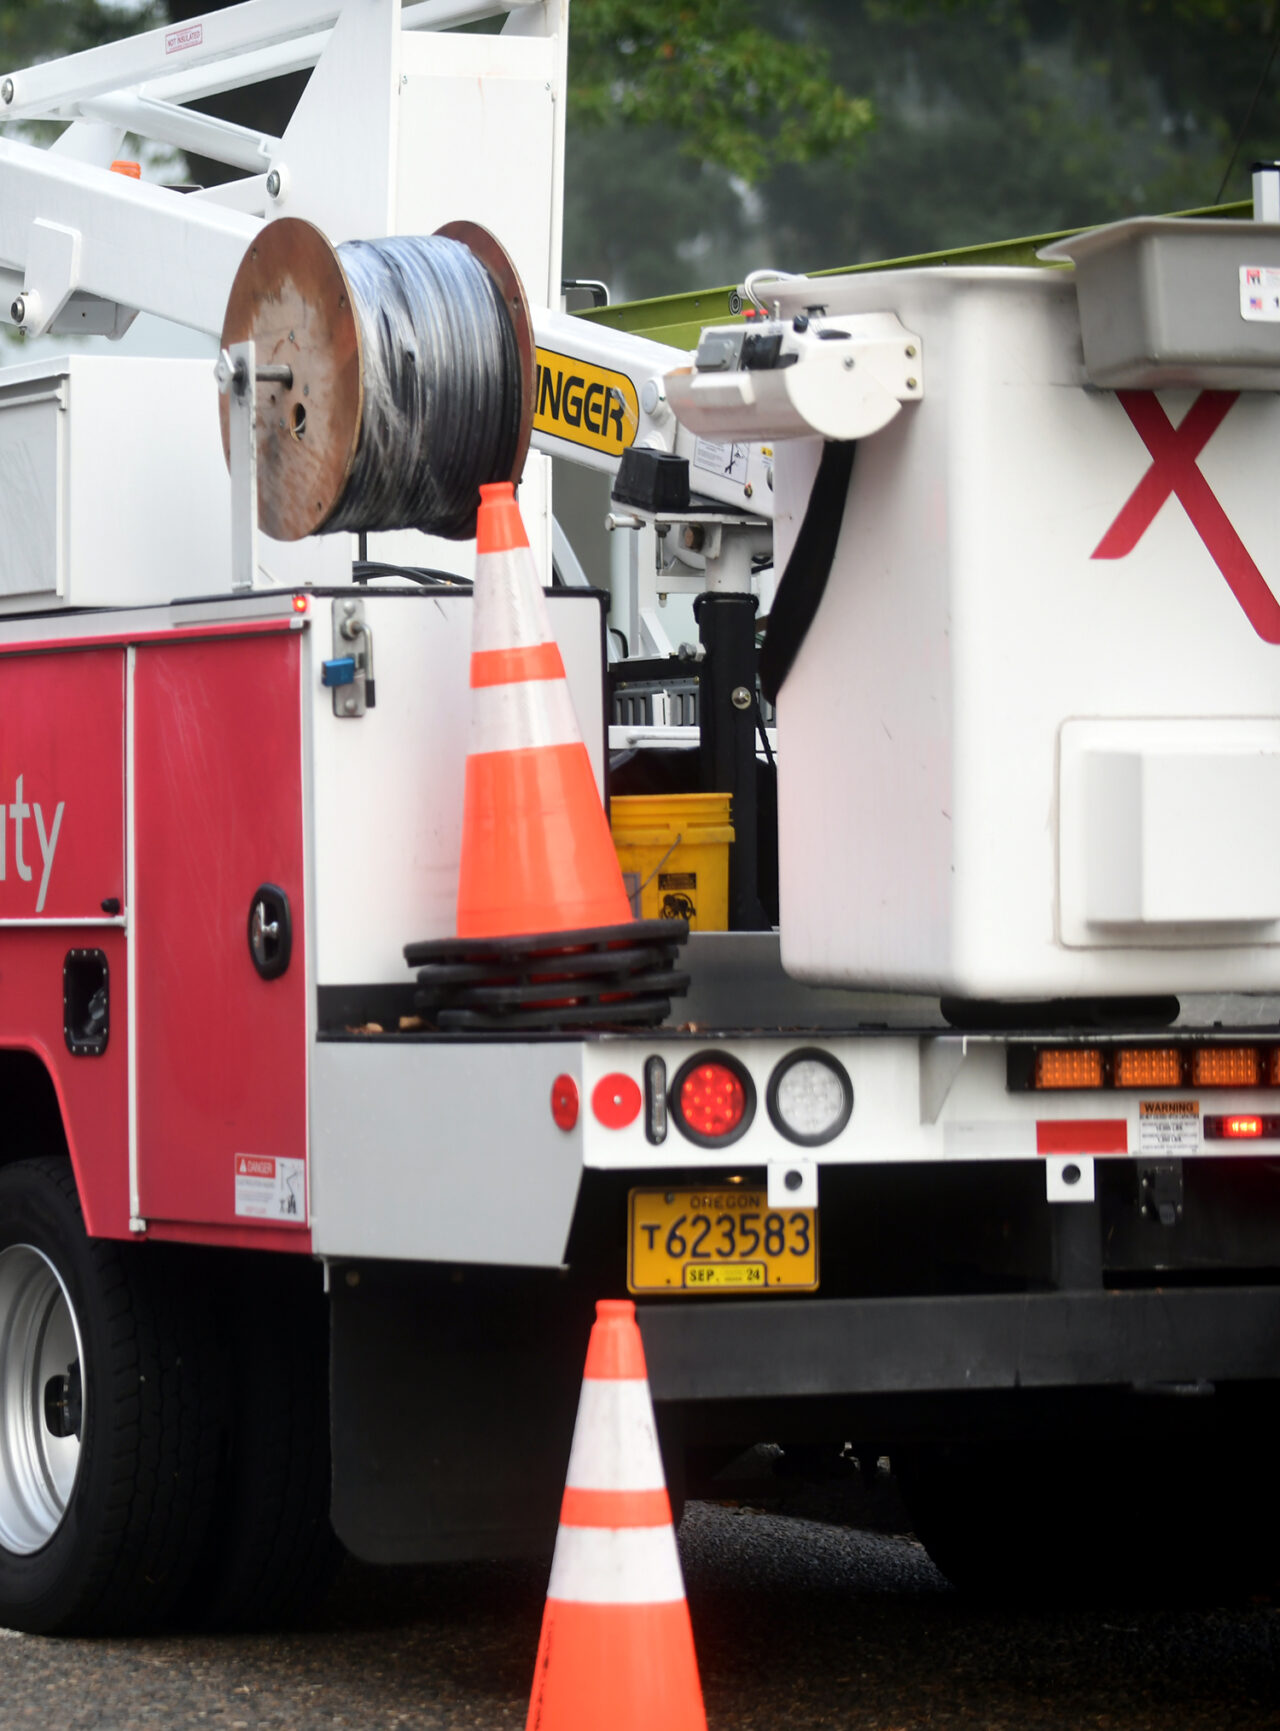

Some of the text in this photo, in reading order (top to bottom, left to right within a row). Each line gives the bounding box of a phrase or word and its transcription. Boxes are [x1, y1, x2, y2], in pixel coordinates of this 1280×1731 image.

[1144, 1102, 1193, 1112] WARNING
[247, 1160, 273, 1175] DANGER
[690, 1195, 761, 1210] OREGON
[641, 1212, 811, 1259] T623583
[746, 1268, 761, 1282] 24
